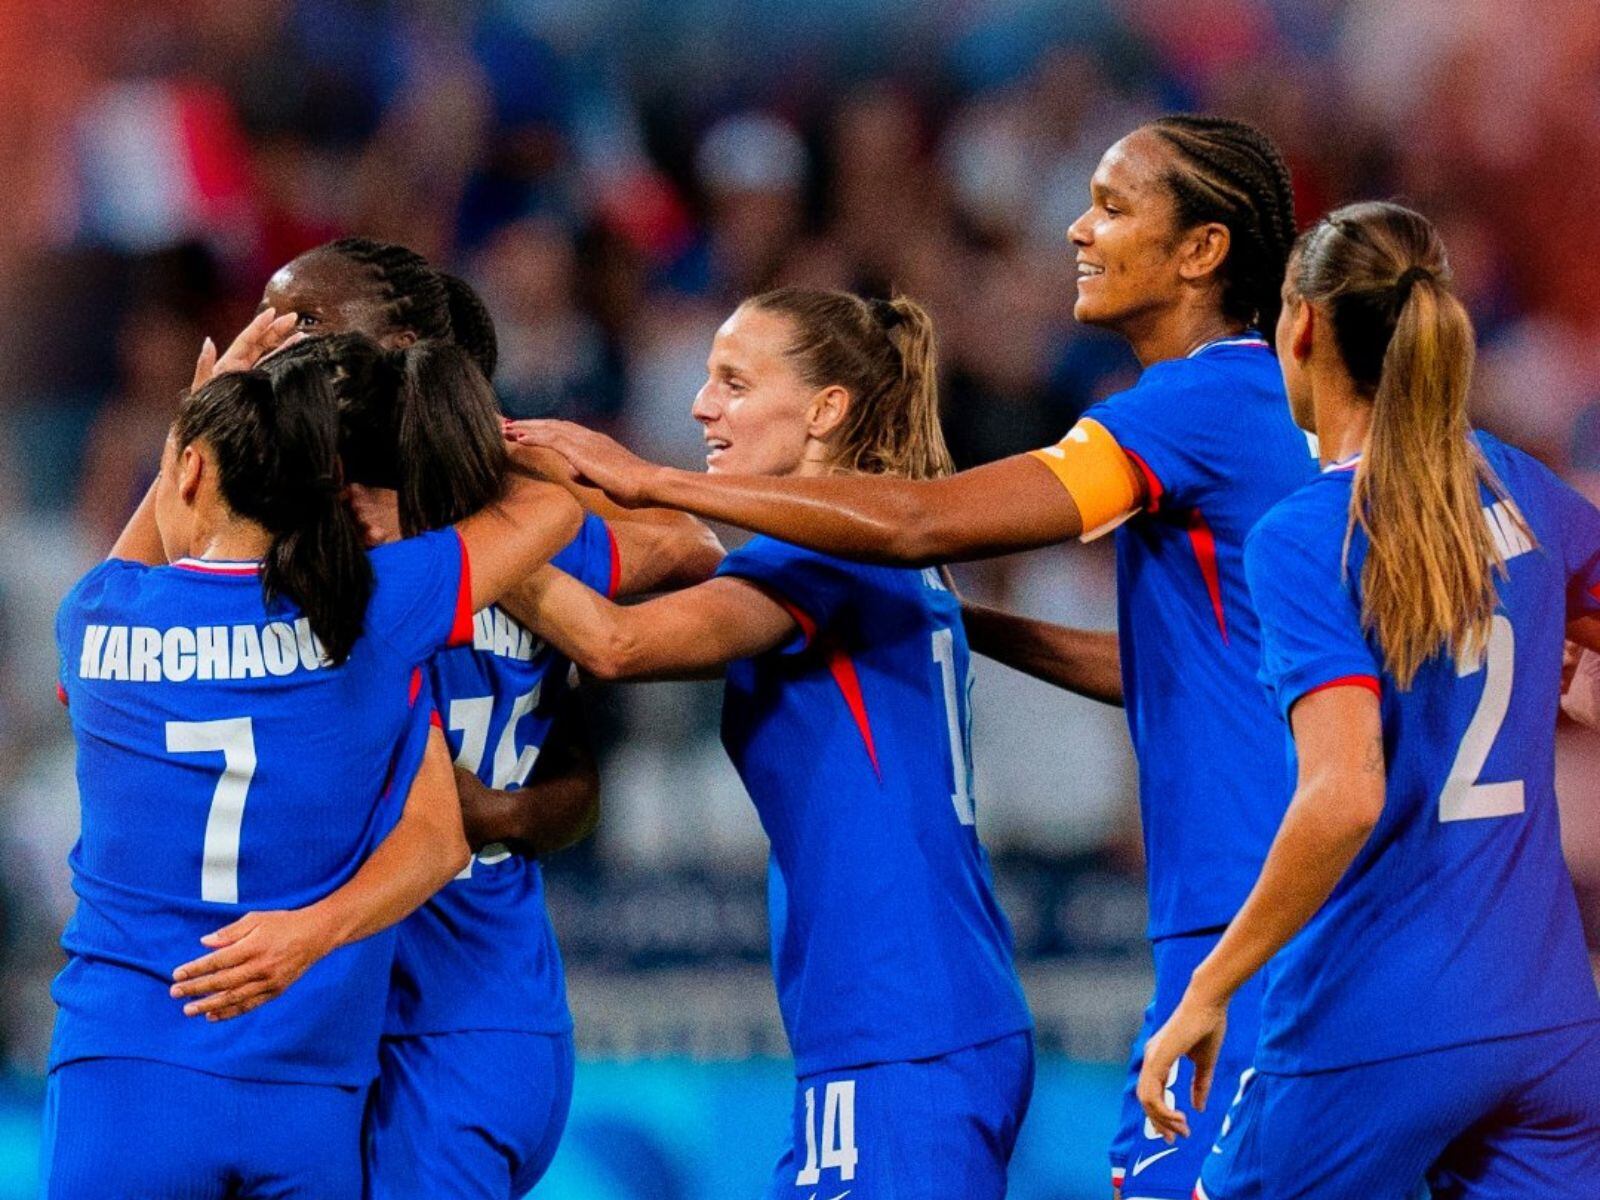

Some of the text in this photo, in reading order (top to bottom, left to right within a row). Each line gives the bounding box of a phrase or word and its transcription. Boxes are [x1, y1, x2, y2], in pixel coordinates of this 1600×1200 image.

[79, 617, 350, 682] KARCHAOU
[1438, 615, 1526, 823] 2
[165, 716, 257, 904] 7
[795, 1080, 859, 1186] 14
